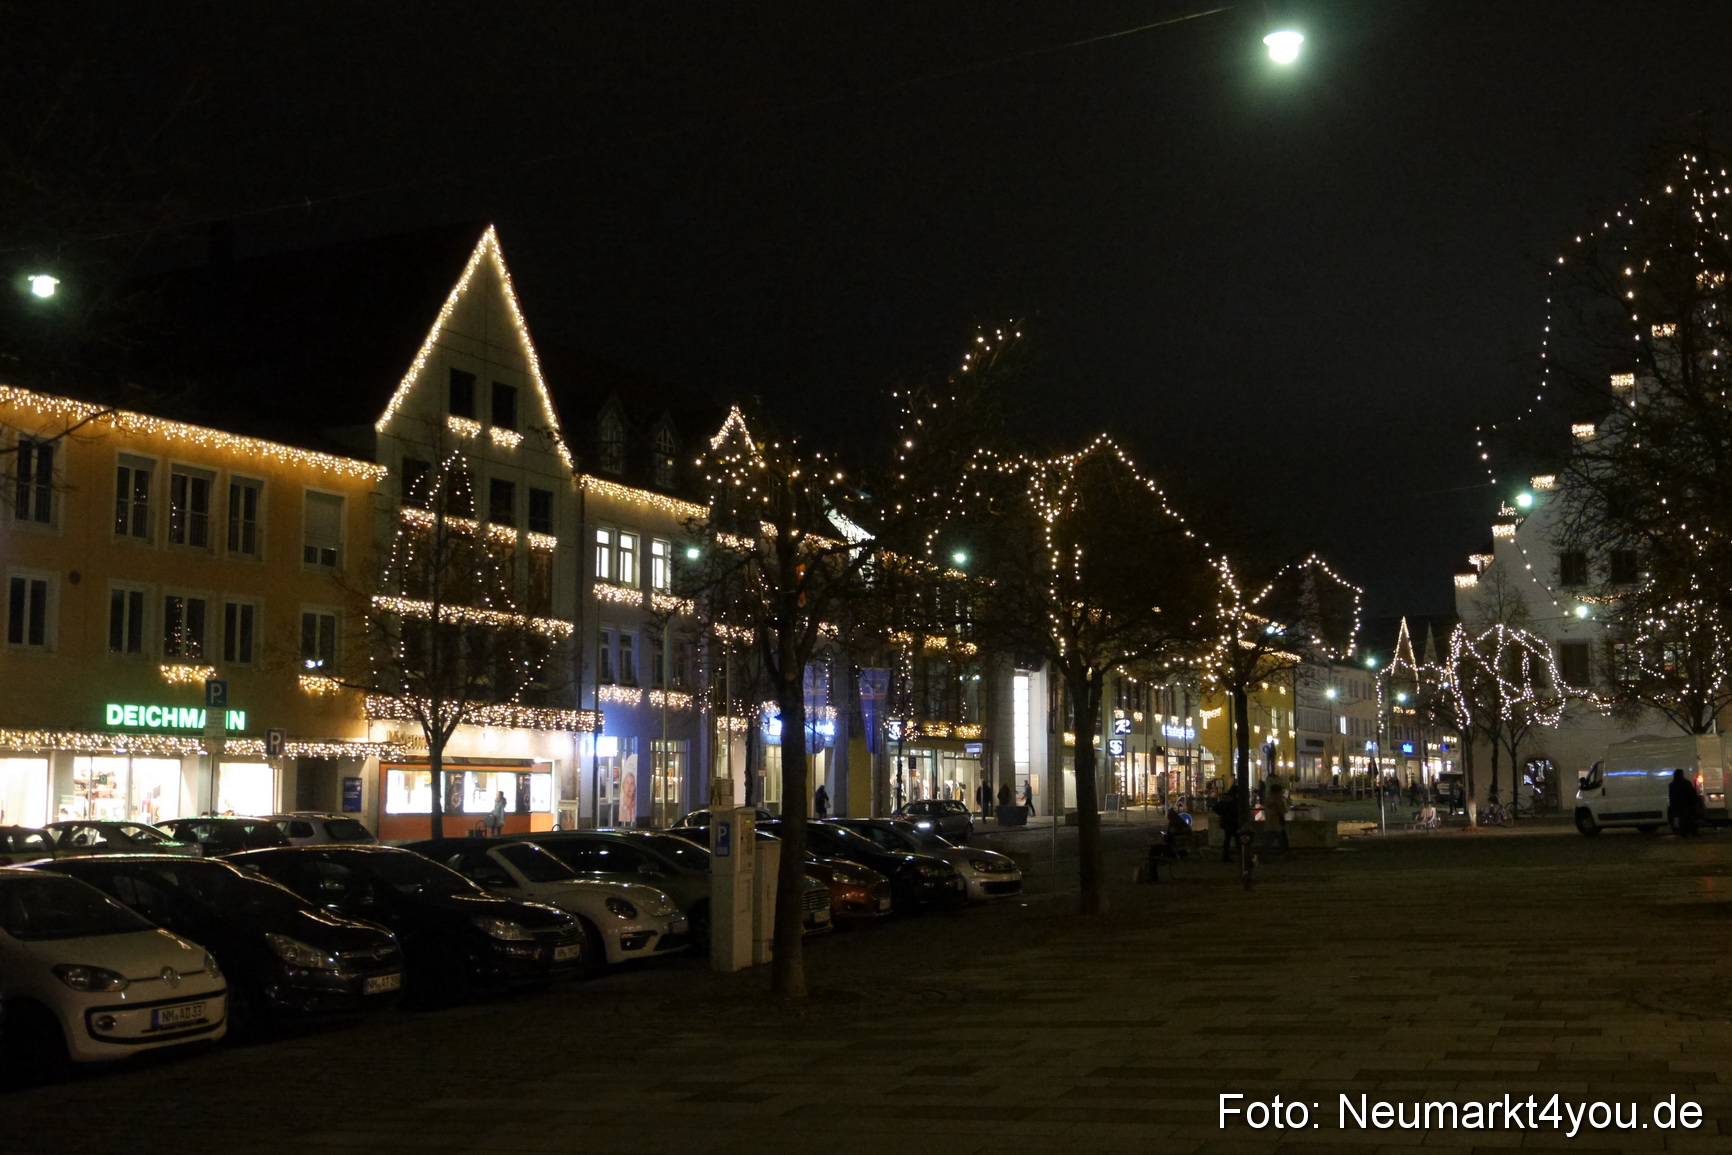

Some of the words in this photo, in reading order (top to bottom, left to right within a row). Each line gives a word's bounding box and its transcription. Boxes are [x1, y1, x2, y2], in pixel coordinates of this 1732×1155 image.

[211, 683, 222, 704] P
[106, 704, 246, 730] DEICHMN
[270, 732, 281, 751] P
[718, 826, 727, 842] P
